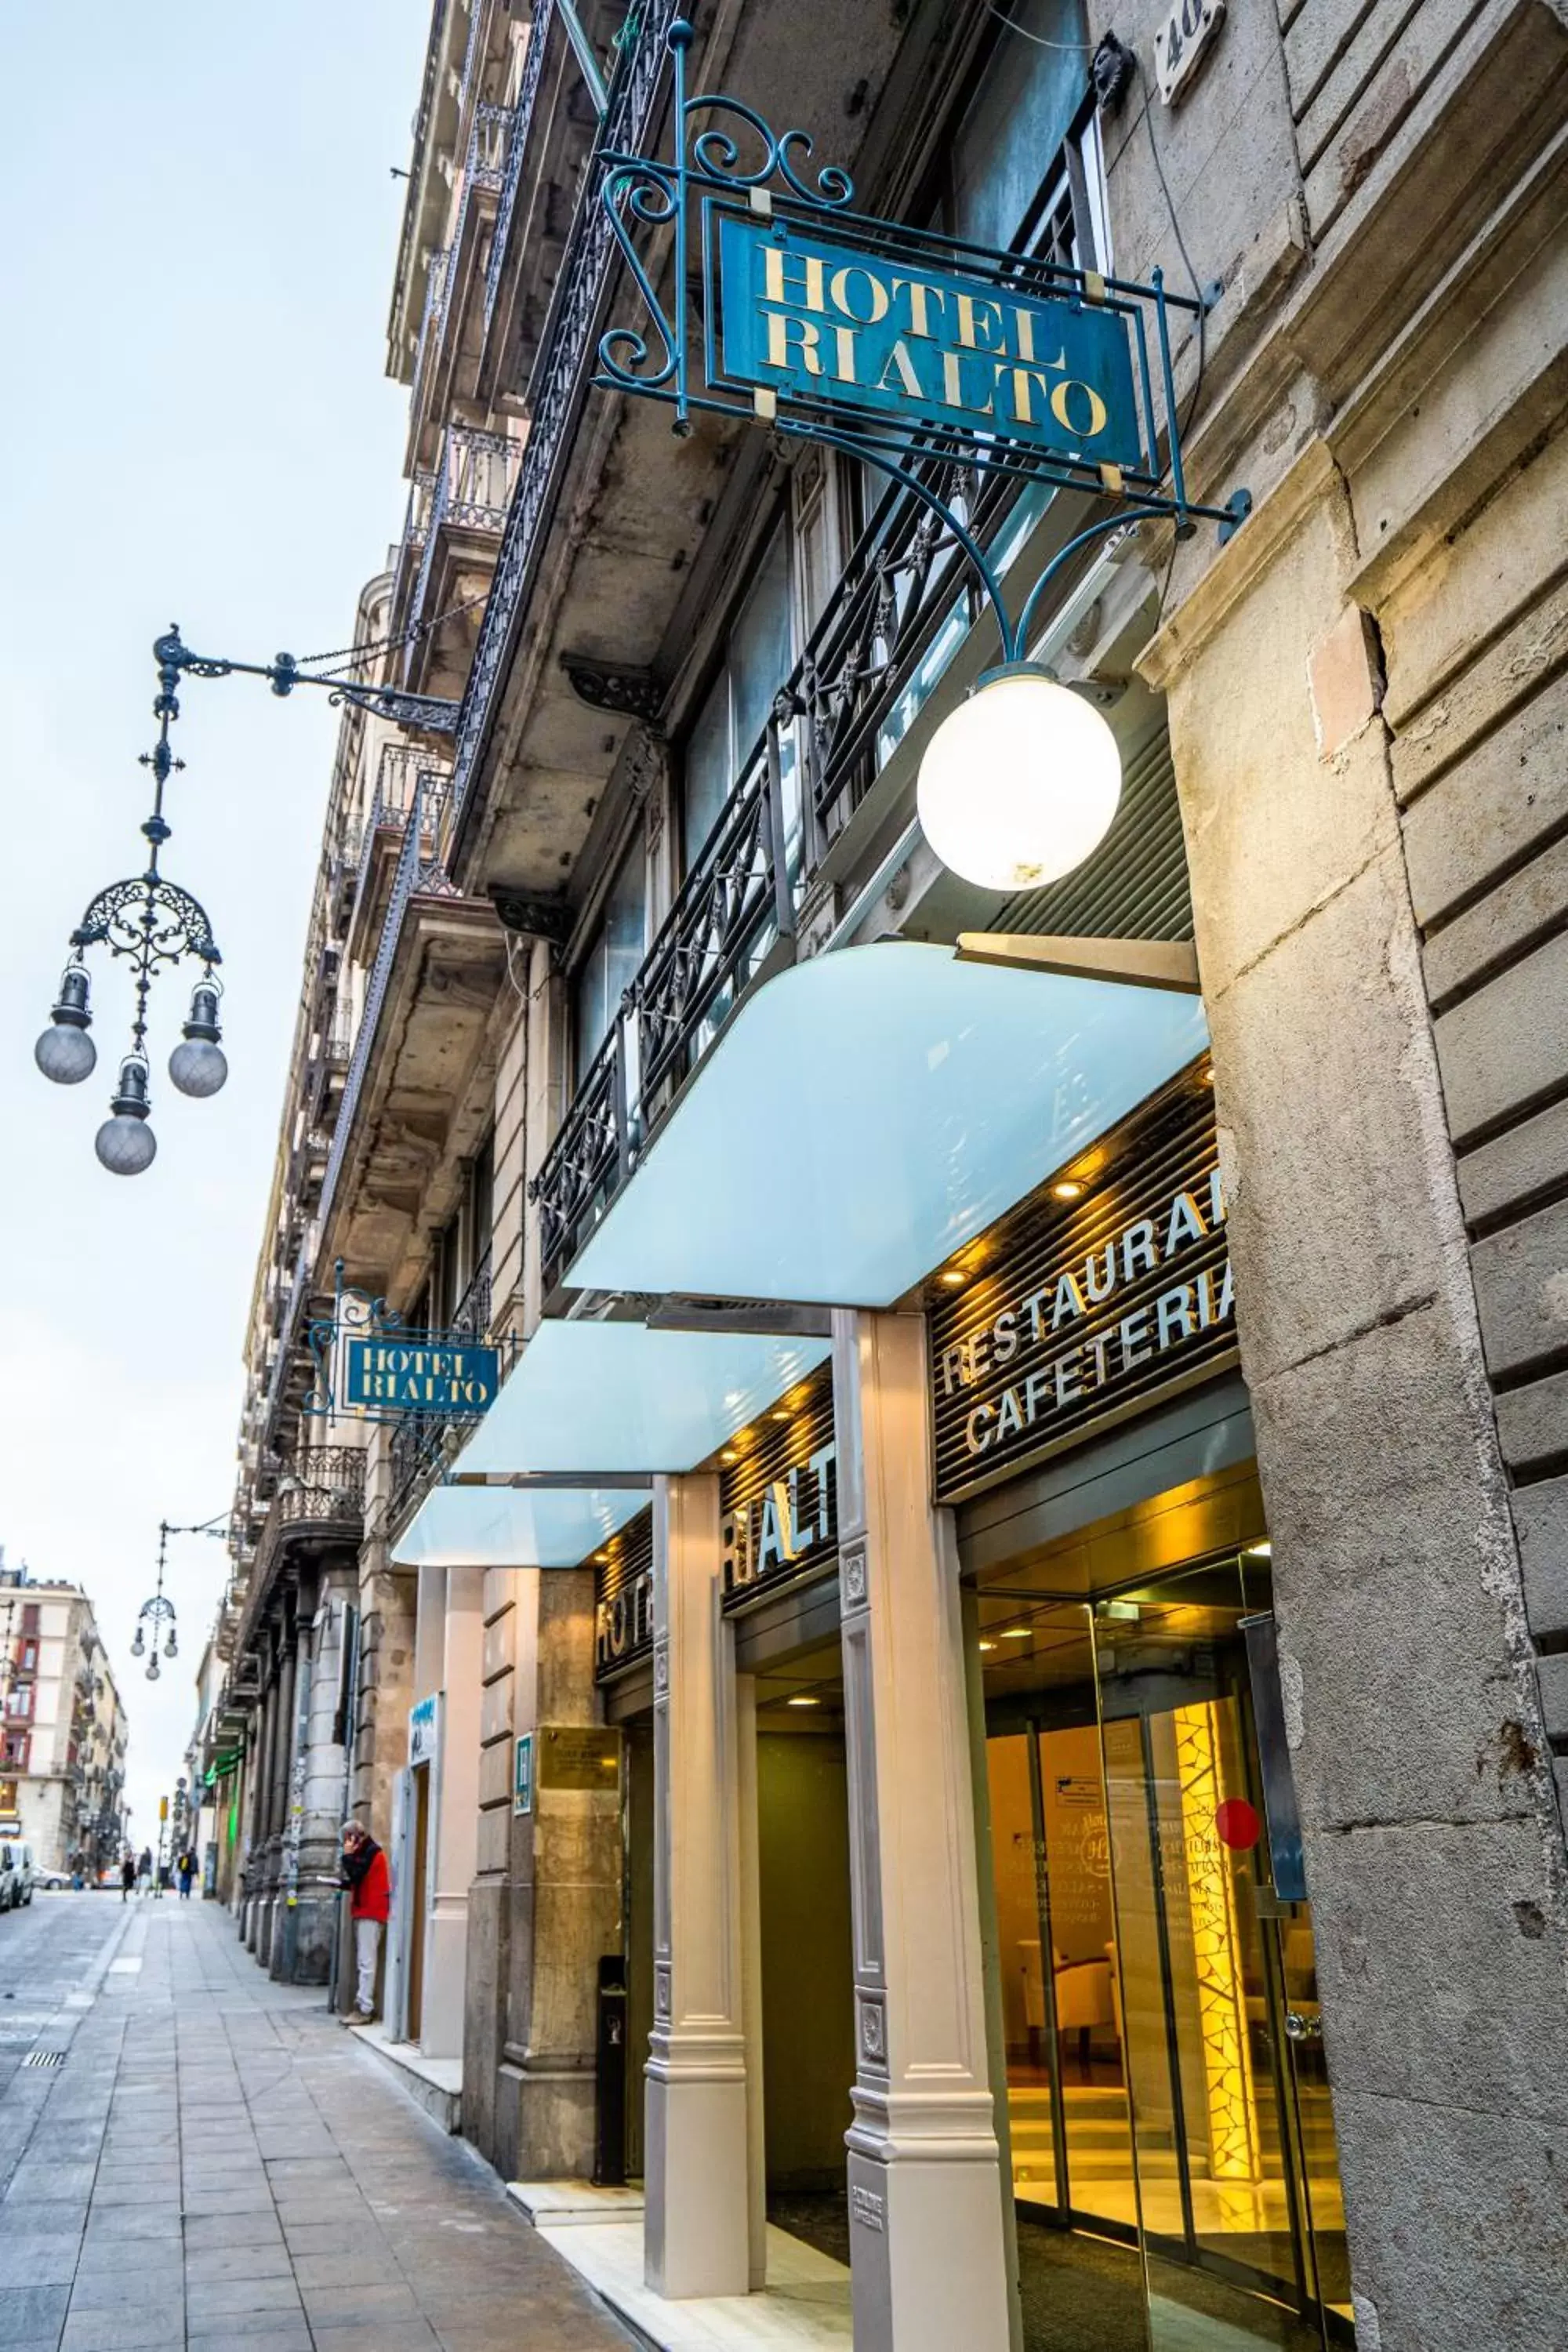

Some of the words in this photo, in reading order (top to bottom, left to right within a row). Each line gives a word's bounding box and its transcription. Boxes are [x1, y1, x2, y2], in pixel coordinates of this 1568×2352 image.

[756, 245, 1066, 370] HOTEL
[757, 310, 1107, 438] RIALTO
[362, 1373, 488, 1404] RIALTO
[363, 1347, 473, 1378] HOTEL
